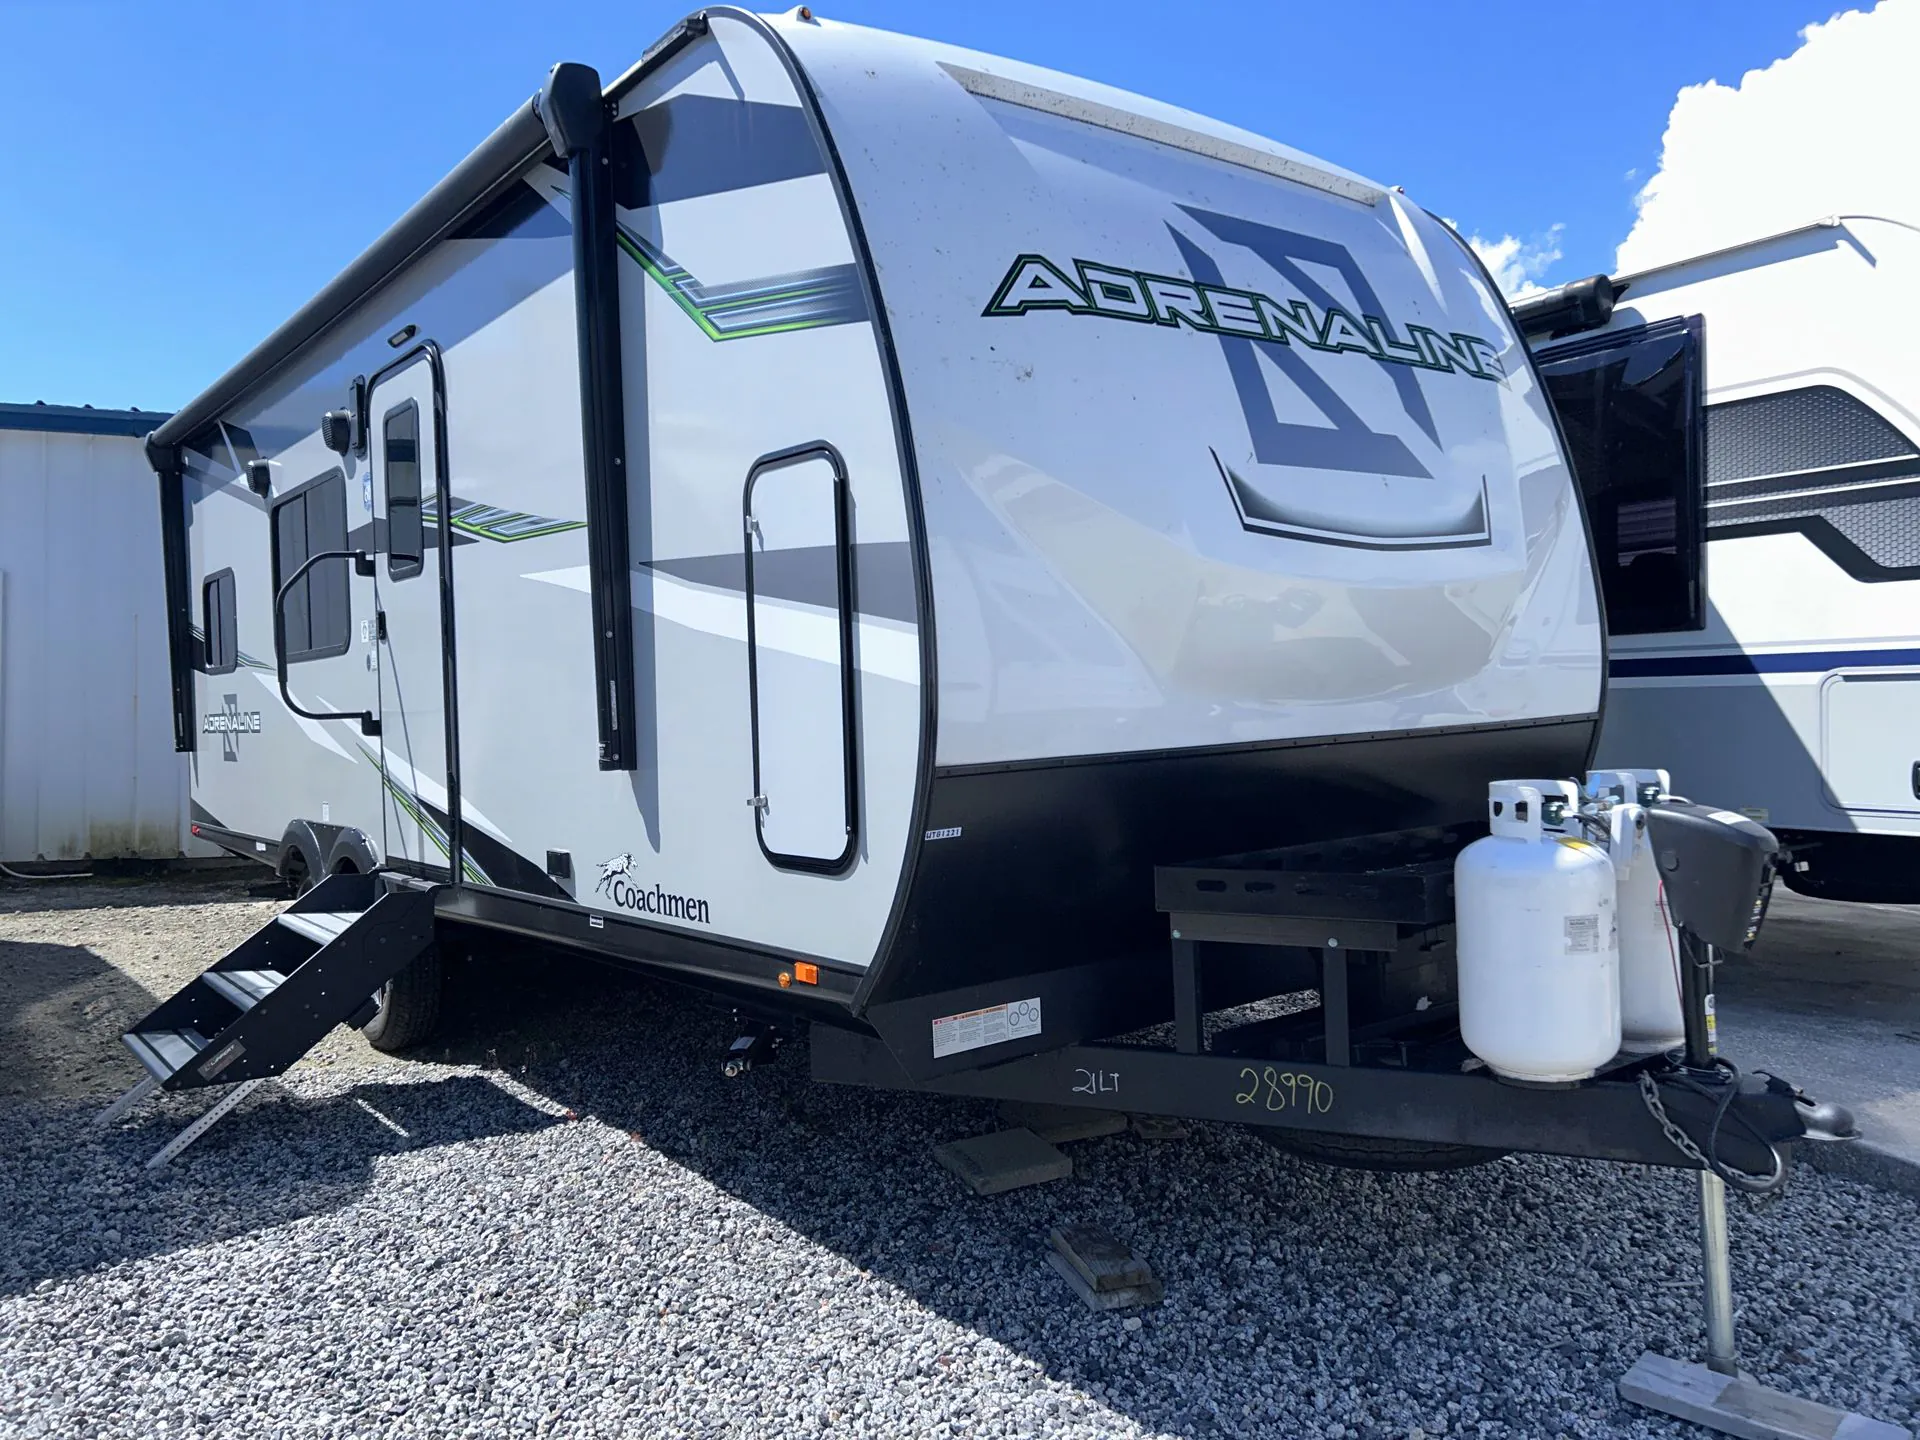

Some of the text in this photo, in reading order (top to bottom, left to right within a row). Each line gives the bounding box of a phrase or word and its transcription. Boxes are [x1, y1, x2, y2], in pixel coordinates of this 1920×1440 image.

[981, 254, 1513, 391] ADRENALINE
[202, 711, 261, 733] ADRENALINE
[613, 880, 711, 924] Coachmen
[1236, 1066, 1334, 1114] 28990
